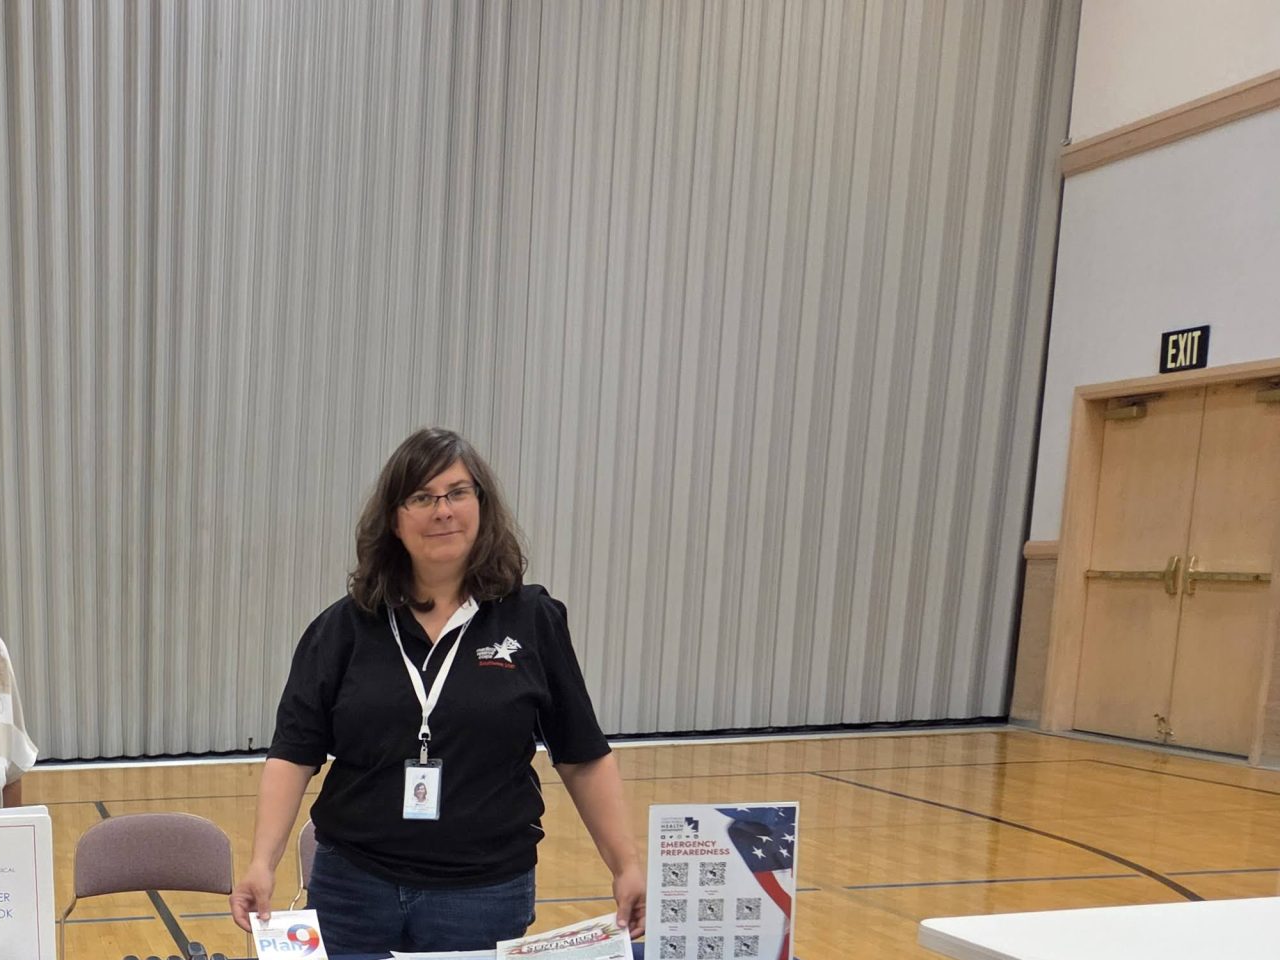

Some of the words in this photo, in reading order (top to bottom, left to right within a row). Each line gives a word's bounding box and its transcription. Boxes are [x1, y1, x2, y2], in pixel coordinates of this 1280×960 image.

[1167, 330, 1201, 369] EXIT
[660, 840, 717, 848] EMERGENCY
[660, 848, 730, 856] PREPAREDNESS
